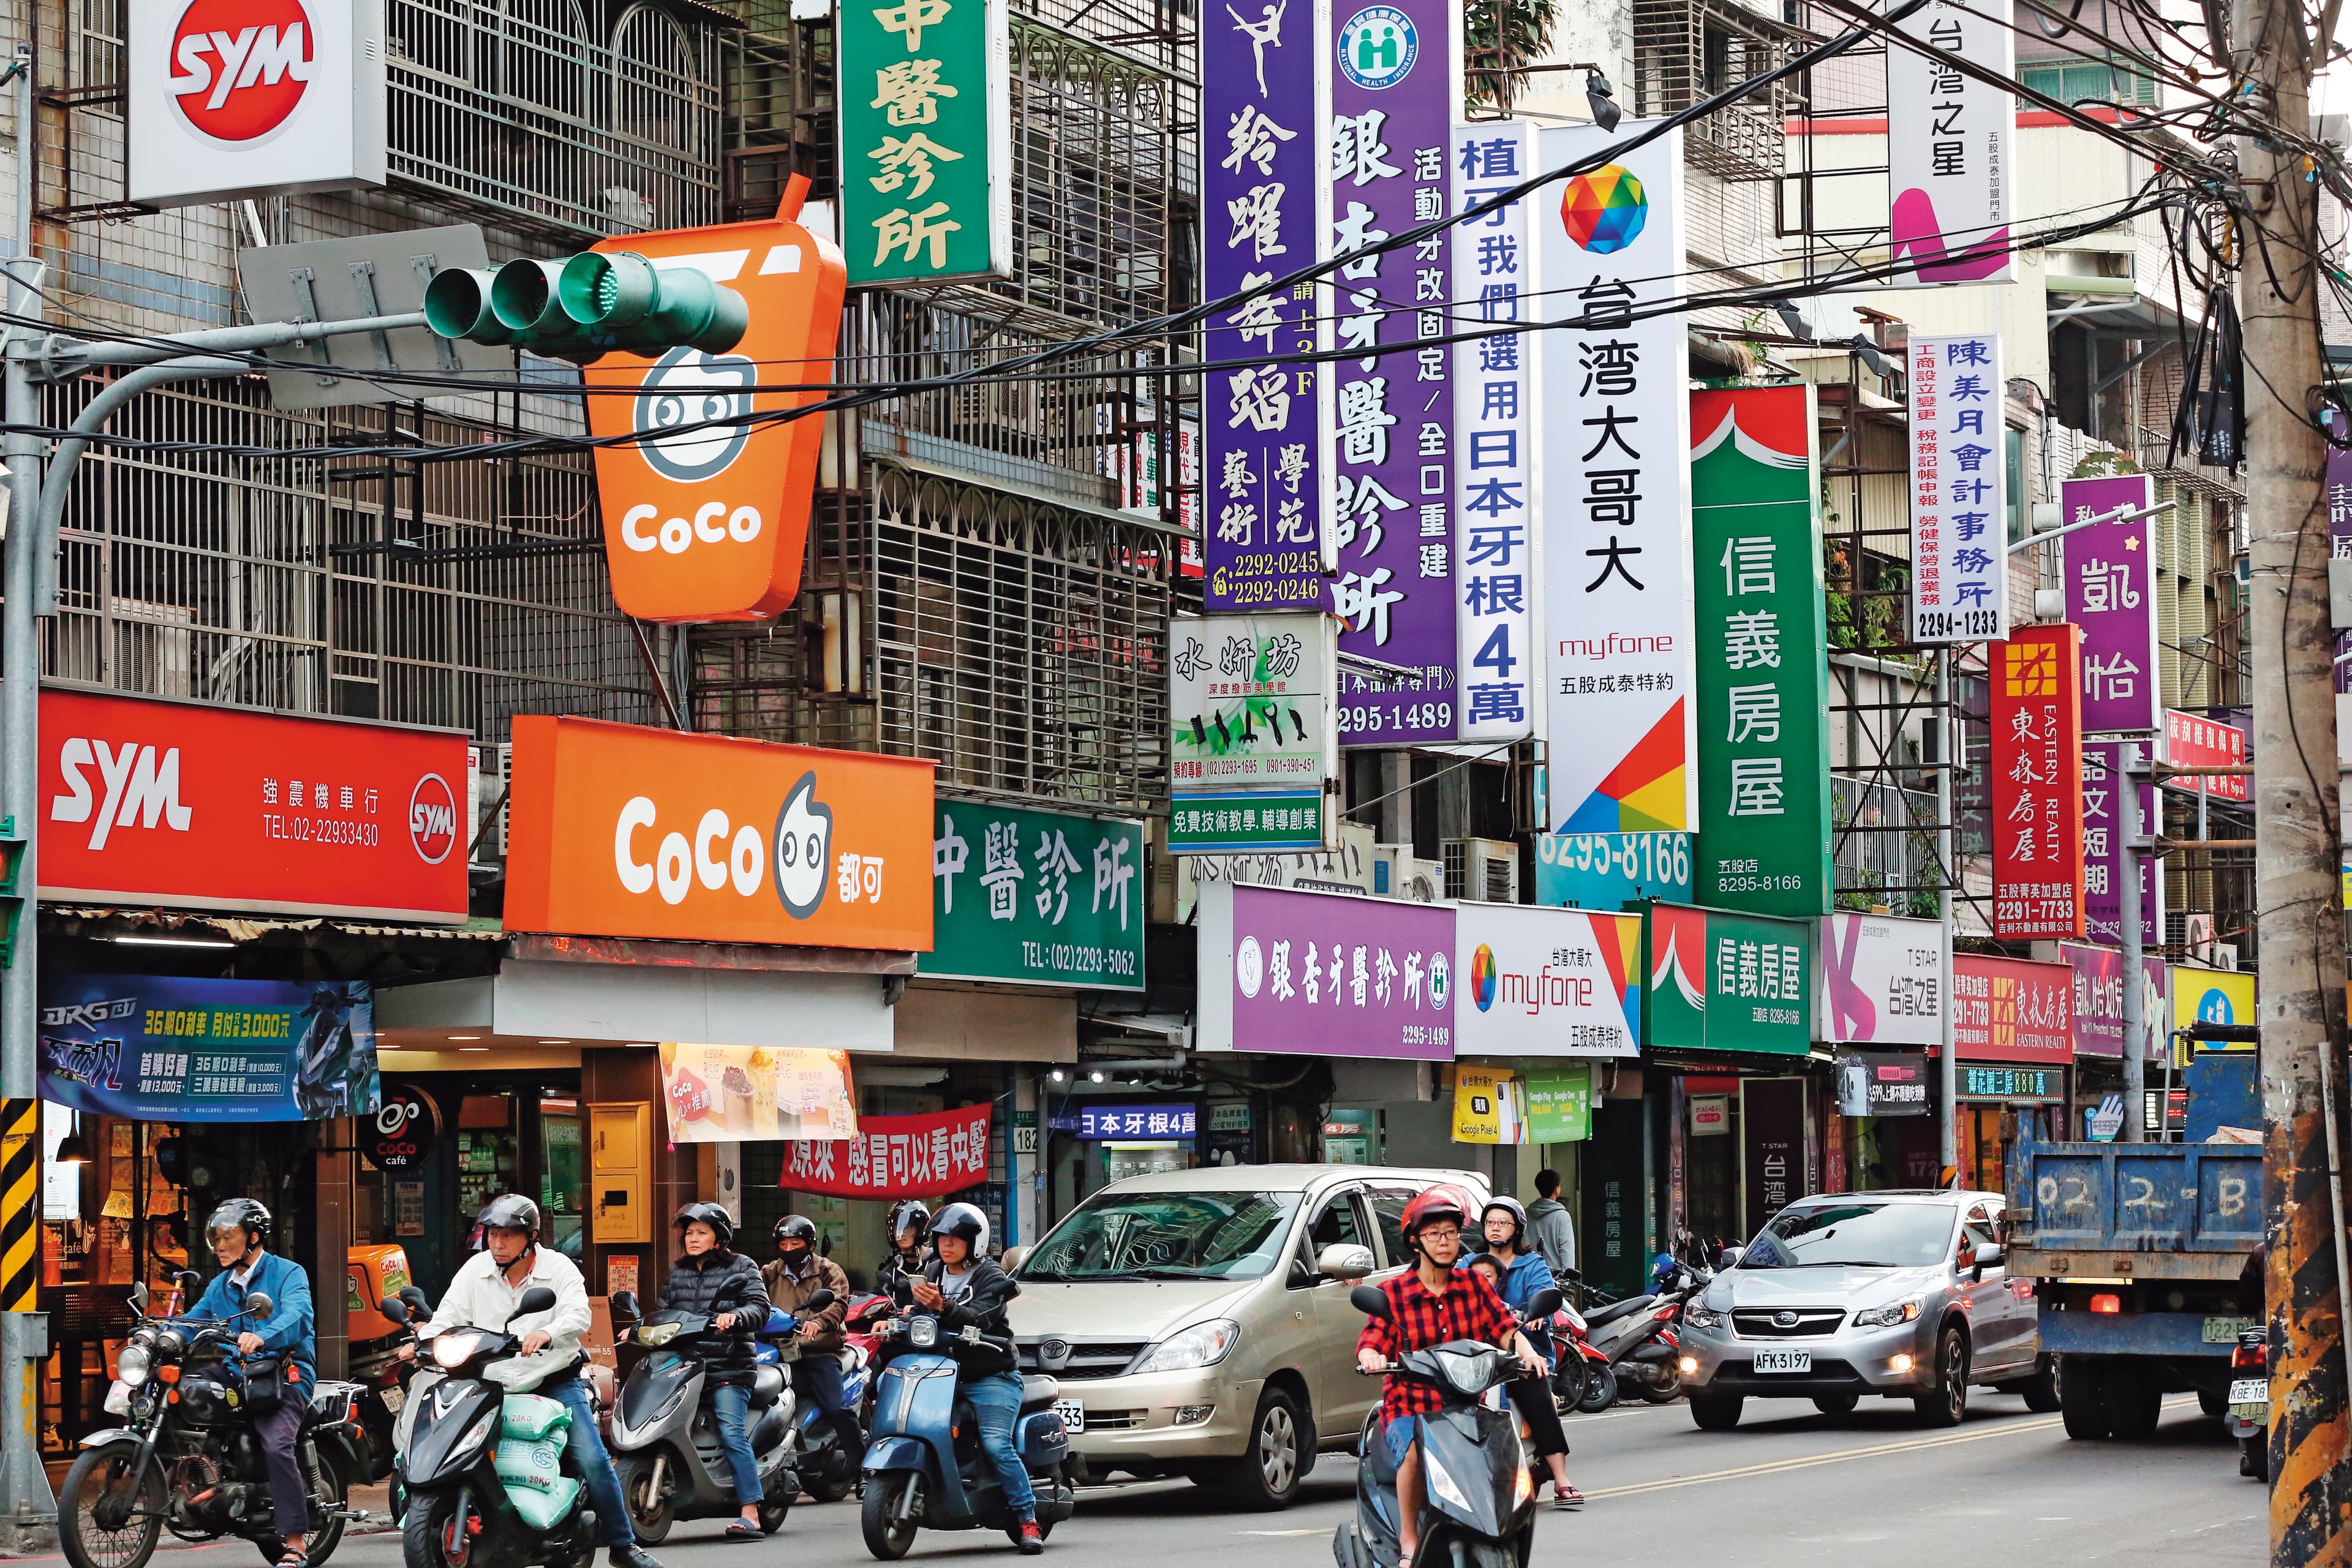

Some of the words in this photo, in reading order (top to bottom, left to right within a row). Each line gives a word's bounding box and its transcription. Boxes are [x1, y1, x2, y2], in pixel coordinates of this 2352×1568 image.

[1936, 0, 1965, 9] STR
[165, 21, 314, 111] SYM
[1341, 48, 1357, 80] NATIONAL
[1362, 78, 1388, 86] HEALTH
[1393, 44, 1414, 80] INSURANCE
[868, 0, 964, 270] 中醫診所
[1988, 132, 2000, 221] 五股成泰加盟門市
[1330, 109, 1410, 647] 銀杏牙醫診所
[1915, 344, 1936, 421] 工商設立變更
[1459, 137, 1525, 725] 植牙我們選用日本牙根4萬
[1917, 429, 1938, 507] 稅務記帳申報
[1948, 340, 1994, 608] 陳美月會計事務所
[1216, 448, 1258, 546] 藝術
[1274, 443, 1314, 544] 學苑
[622, 502, 761, 554] CoCo
[1234, 551, 1318, 576] 2292-0245
[1919, 516, 1940, 606] 勞健保勞退業務
[1234, 578, 1319, 604] 2292-0246
[1919, 610, 1997, 637] 2294-1233
[2082, 558, 2140, 701] 凱怡
[1175, 633, 1300, 681] 水妍坊
[1560, 632, 1672, 660] myfone
[1209, 681, 1286, 695] 深度撥筋美學館
[1560, 673, 1673, 695] 五股成泰特約
[1720, 535, 1785, 817] 信義房屋
[1266, 758, 1315, 773] 0901-390-451
[2044, 705, 2057, 785] EASTERN
[50, 737, 192, 851] SYM
[262, 777, 379, 815] 強震機車行
[2008, 706, 2044, 862] 東森房屋
[2231, 781, 2244, 796] Spa
[263, 814, 379, 848] TEL:02-22933430
[412, 802, 455, 843] SYM
[2046, 799, 2059, 862] REALTY
[614, 796, 764, 905] CoCo
[1539, 833, 1688, 886] 8295-8166
[1718, 859, 1758, 875] 五股店
[837, 851, 884, 903] 都可
[933, 814, 1134, 932] 中醫診所
[1718, 875, 1801, 892] 8295-8166
[1999, 883, 2072, 899] 五股菁英加盟店
[1998, 901, 2073, 920] 2291-7733
[1999, 922, 2073, 933] 吉利不動產有限公司
[1022, 941, 1134, 976] TEL:(02)2293-5062
[1268, 938, 1425, 1011] 銀杏牙醫診所
[1717, 937, 1800, 1001] 信義房屋
[1908, 949, 1913, 965] T
[1916, 949, 1937, 967] STAR
[1502, 965, 1592, 1015] myfone
[1889, 974, 1937, 1016] 台湾之星
[1954, 974, 1988, 998] 股菁英加盟店
[2016, 980, 2067, 1030] 東森房屋
[1403, 1025, 1449, 1046] 2295-1489
[1752, 1007, 1767, 1023] 五股店
[1770, 1008, 1800, 1025] 8295-8166
[1571, 1025, 1622, 1049] 五股成泰特約
[2017, 1033, 2043, 1048] EASTERN
[2045, 1036, 2067, 1049] REALTY
[673, 1082, 692, 1098] CoCo
[1082, 1112, 1196, 1136] 日本牙根4萬
[1461, 1123, 1479, 1137] Google
[1481, 1123, 1493, 1136] Pixel
[1493, 1125, 1498, 1135] 4
[377, 1142, 417, 1155] CoCo
[386, 1156, 407, 1165] café
[848, 1118, 987, 1187] 感冒可以看中醫
[1604, 1182, 1621, 1257] 信義房屋
[64, 1242, 81, 1254] café
[380, 1260, 396, 1272] CoCo
[529, 1476, 551, 1486] 20KG
